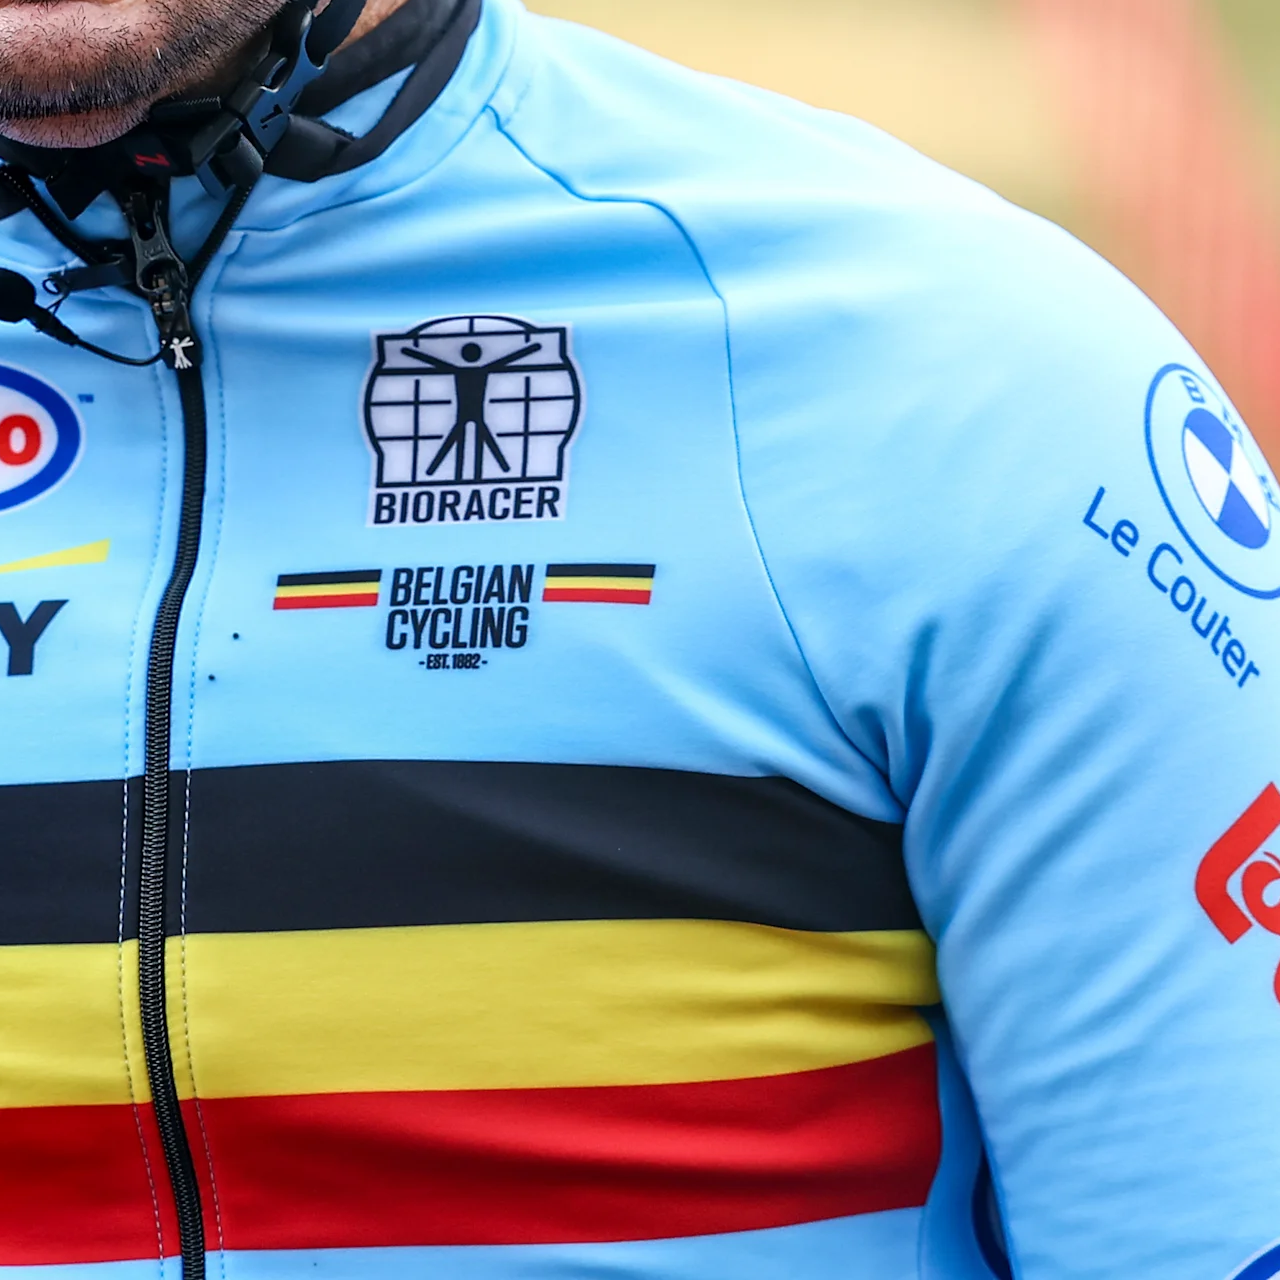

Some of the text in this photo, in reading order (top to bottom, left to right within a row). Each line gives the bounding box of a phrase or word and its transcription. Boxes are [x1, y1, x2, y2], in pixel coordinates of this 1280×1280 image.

[372, 484, 561, 525] BIORACER
[389, 564, 535, 607] BELGIAN
[1082, 486, 1260, 689] Le Couter
[385, 605, 530, 650] CYCLING
